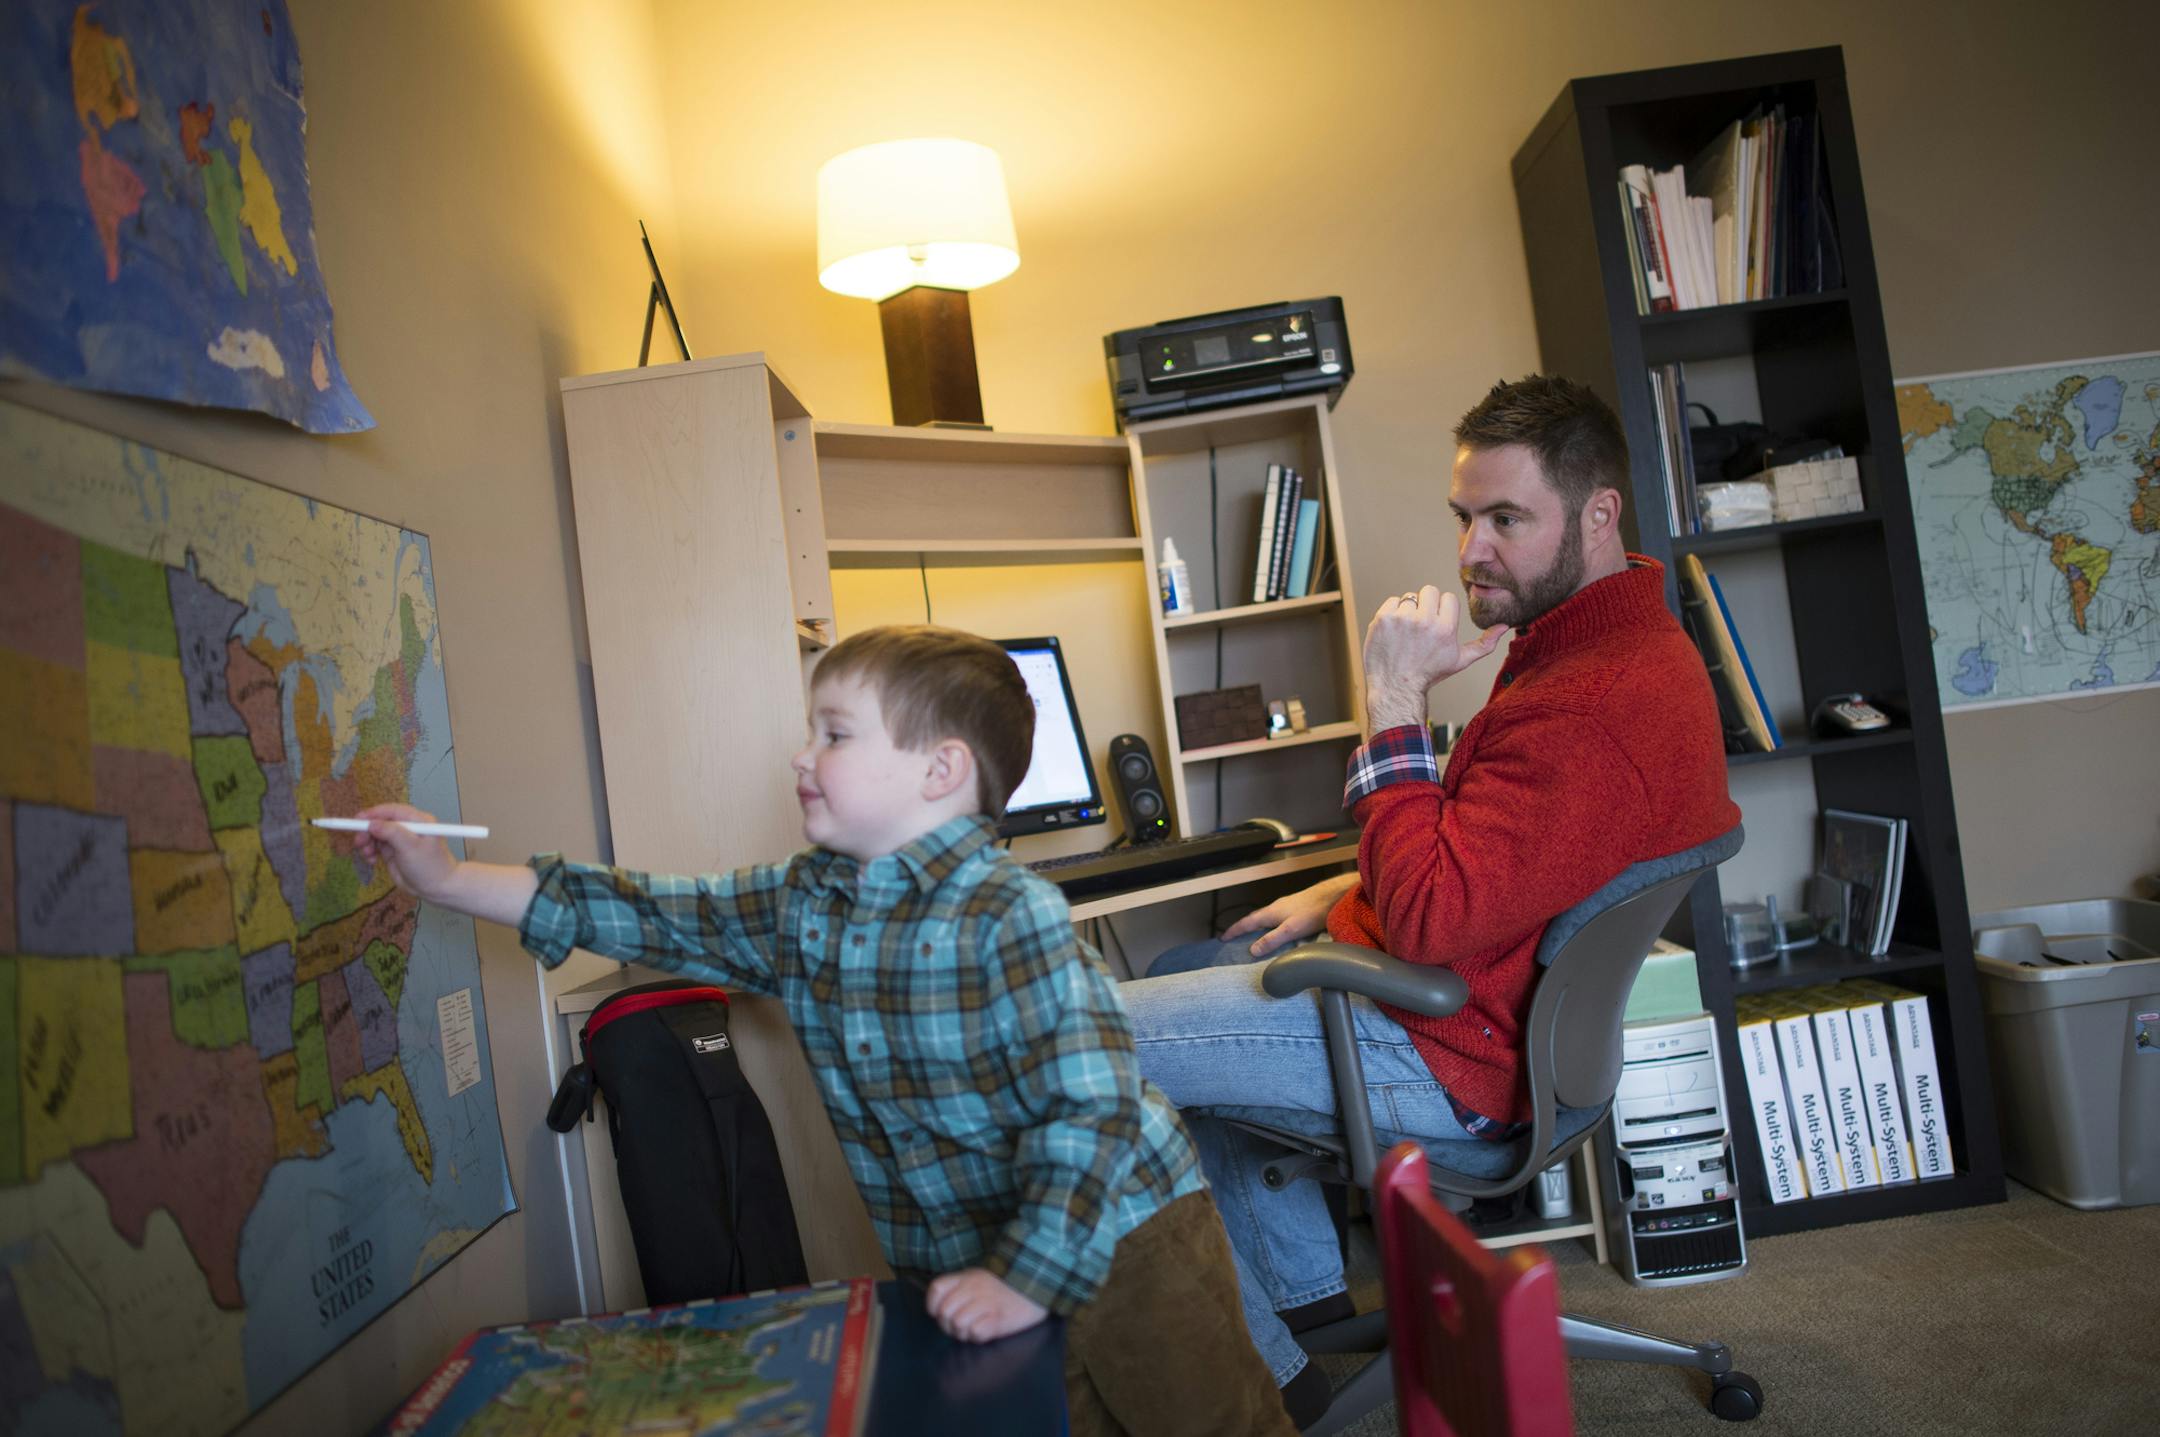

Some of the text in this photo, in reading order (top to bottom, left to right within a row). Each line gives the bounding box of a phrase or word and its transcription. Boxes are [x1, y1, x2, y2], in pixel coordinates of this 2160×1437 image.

[1751, 1031, 1766, 1075] ADVANTAGE
[1790, 1024, 1804, 1069] ADVANTAGE
[1828, 1017, 1841, 1061] ADVANTAGE
[1862, 1013, 1877, 1057] ADVANTAGE
[1907, 1004, 1920, 1049] ADVANTAGE
[1764, 1101, 1792, 1198] Multi-System
[1803, 1094, 1831, 1191] Multi-System
[1840, 1088, 1865, 1185] Multi-System
[1875, 1083, 1901, 1180] Multi-System
[1916, 1075, 1940, 1173] Multi-System
[311, 1239, 373, 1298] UNITED
[328, 1225, 351, 1253] THE
[319, 1268, 375, 1329] STATES
